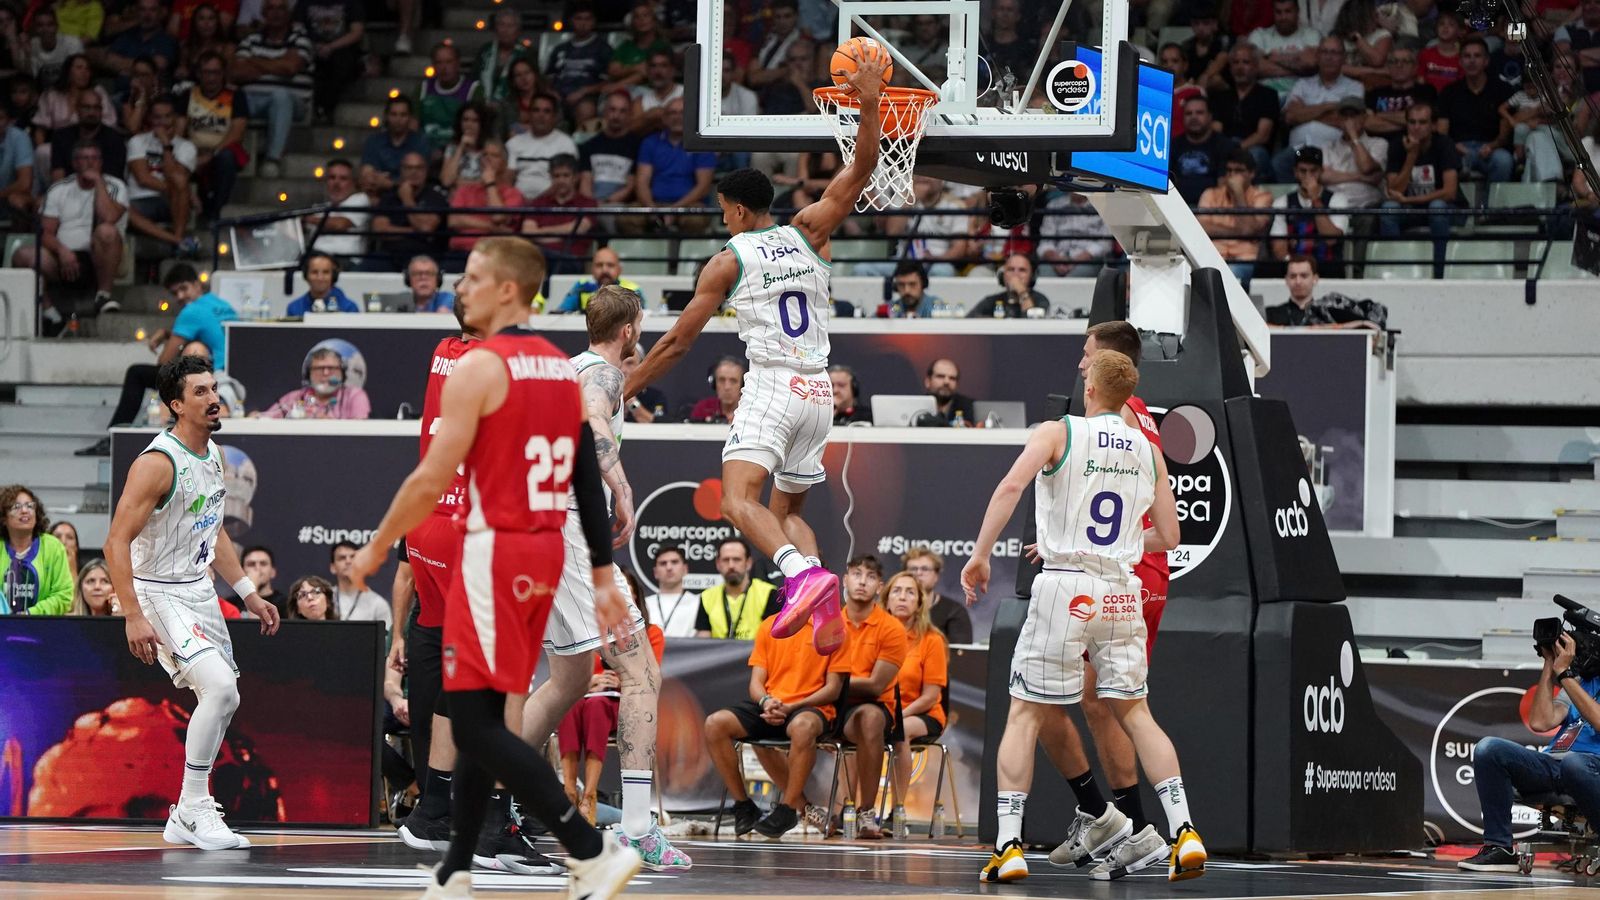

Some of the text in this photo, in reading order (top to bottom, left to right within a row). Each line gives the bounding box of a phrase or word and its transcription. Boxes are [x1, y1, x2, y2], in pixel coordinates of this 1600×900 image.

[1057, 86, 1087, 94] endesa
[779, 290, 809, 339] 0
[431, 356, 457, 377] BIRG
[1098, 431, 1133, 452] Díaz
[525, 435, 574, 512] 22
[1086, 491, 1123, 546] 9
[1275, 500, 1308, 537] acb
[639, 525, 730, 542] supercopa
[195, 541, 208, 565] 14
[1103, 594, 1136, 604] COSTA
[1121, 605, 1137, 613] SOL
[1303, 675, 1344, 734] acb
[1363, 766, 1396, 791] endesa
